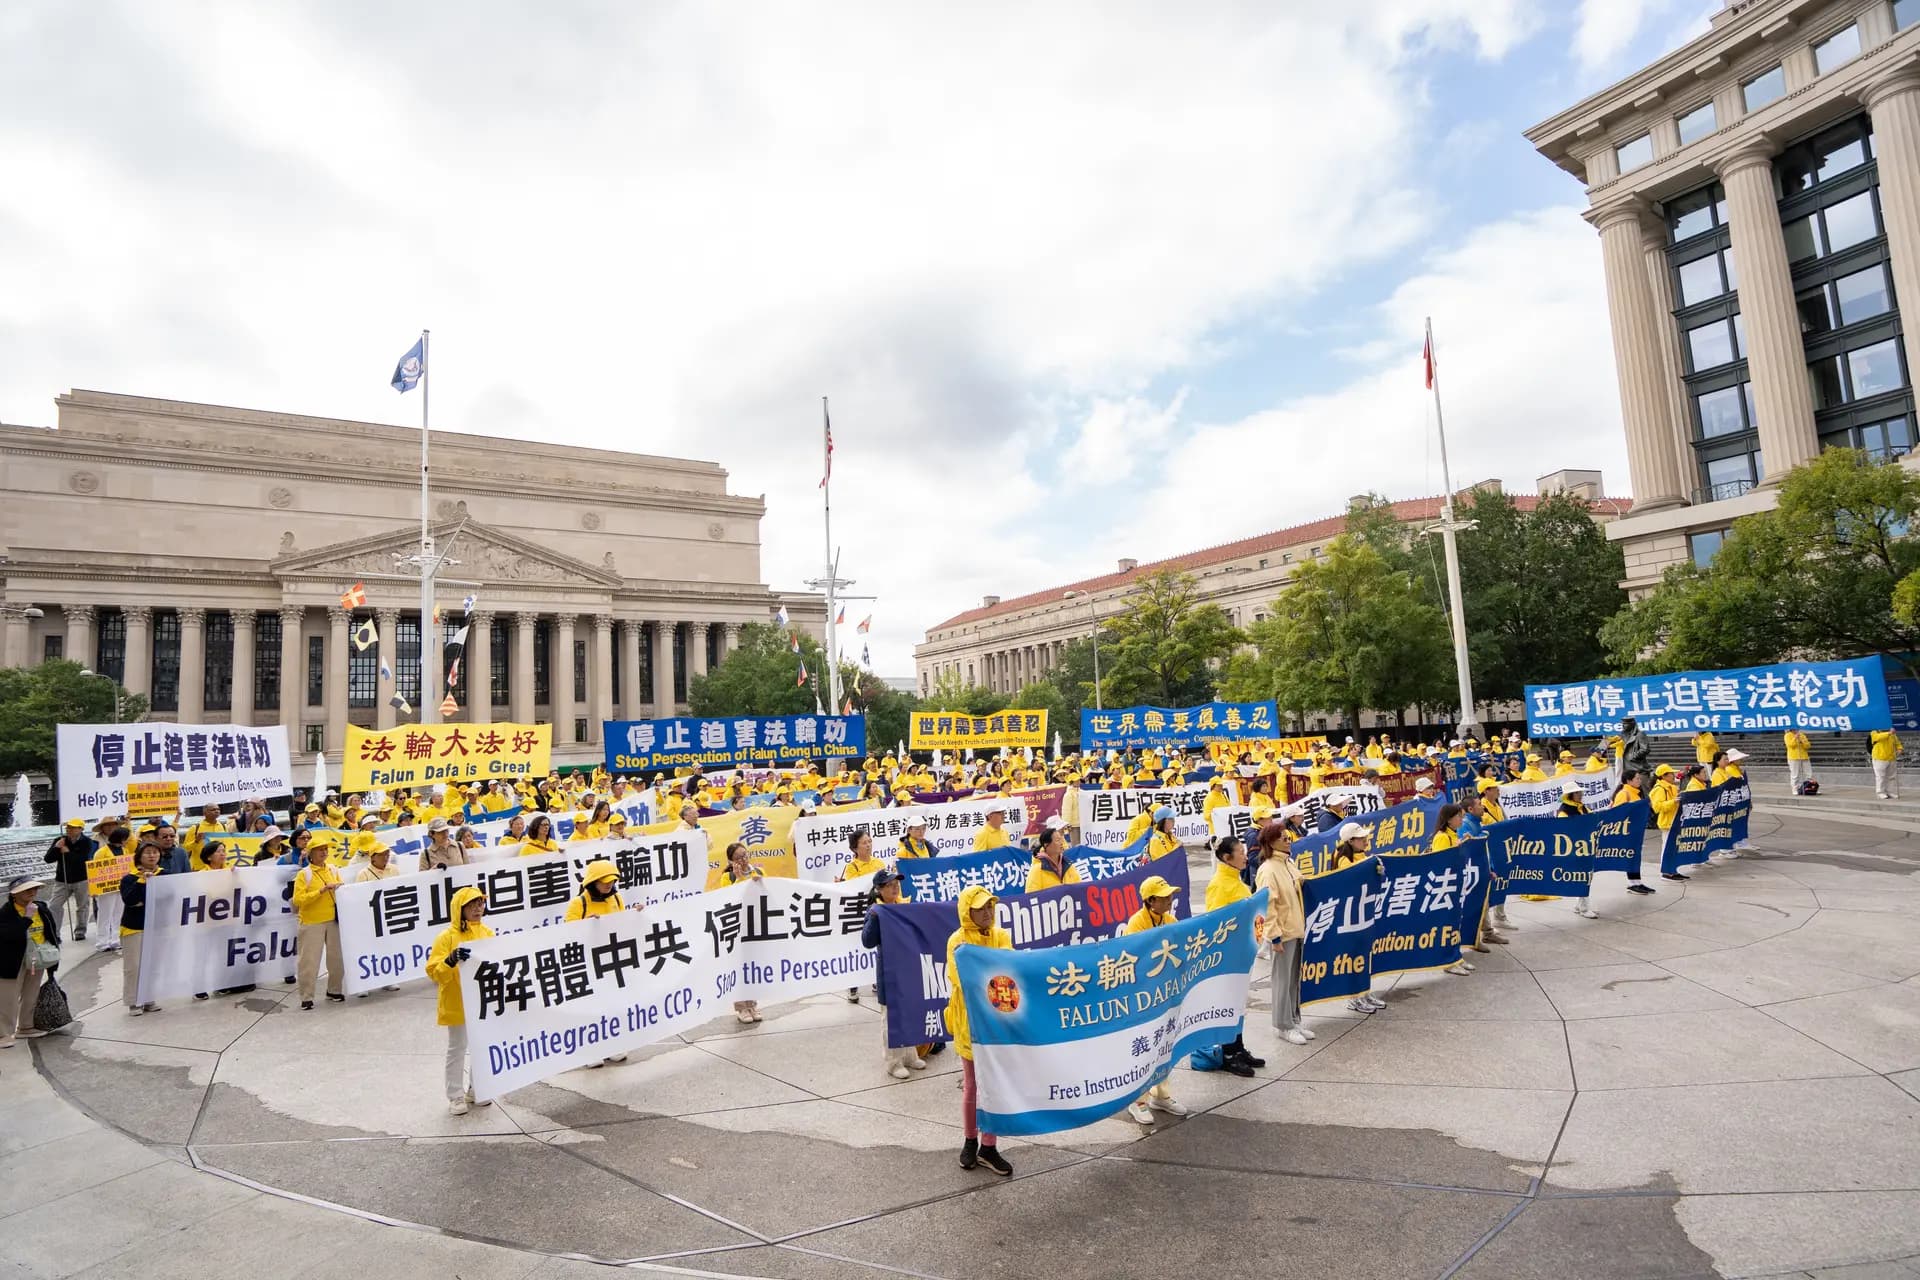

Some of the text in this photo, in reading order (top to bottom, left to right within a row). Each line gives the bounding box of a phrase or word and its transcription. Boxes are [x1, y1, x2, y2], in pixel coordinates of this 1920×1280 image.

[627, 717, 848, 755] 停止迫害法輪功
[919, 714, 1040, 736] 世界需要真善忍
[1532, 711, 1852, 736] Stop Perseution Of Falun Gong
[92, 732, 271, 778] 停止迫害法輪功
[361, 729, 539, 761] 法輪大法好
[615, 741, 858, 773] Stop Persecution of Falun Gong in China
[1126, 738, 1145, 746] Needs
[371, 760, 531, 785] Falun Dafa is Great
[78, 792, 107, 809] Help
[202, 784, 212, 796] of
[213, 781, 235, 795] Falun
[237, 780, 255, 792] Gong
[262, 778, 283, 789] China
[740, 816, 772, 846] 善
[1084, 829, 1103, 846] Stop
[1173, 823, 1190, 838] alun
[1191, 822, 1209, 838] Gong
[805, 855, 830, 871] CCP
[938, 836, 966, 849] Gong
[180, 888, 267, 927] Help
[369, 842, 690, 938] 停止迫害輪功
[995, 882, 1139, 945] China: Stop
[359, 950, 405, 980] Stop
[1046, 917, 1239, 997] 法輪大法好
[1333, 952, 1365, 976] the
[1418, 926, 1437, 949] of
[473, 919, 693, 1020] 解體中共
[1060, 995, 1129, 1030] FALUN
[1136, 976, 1181, 1013] DAFA
[1187, 951, 1223, 981] GOOD
[488, 1013, 621, 1076] Disintegrate
[627, 1004, 659, 1033] the
[716, 967, 737, 1000] Stop
[743, 961, 773, 987] the
[780, 947, 878, 982] Persecution
[1049, 1081, 1081, 1101] Free
[1084, 1061, 1150, 1098] Instruction
[1182, 1006, 1234, 1030] Exercises
